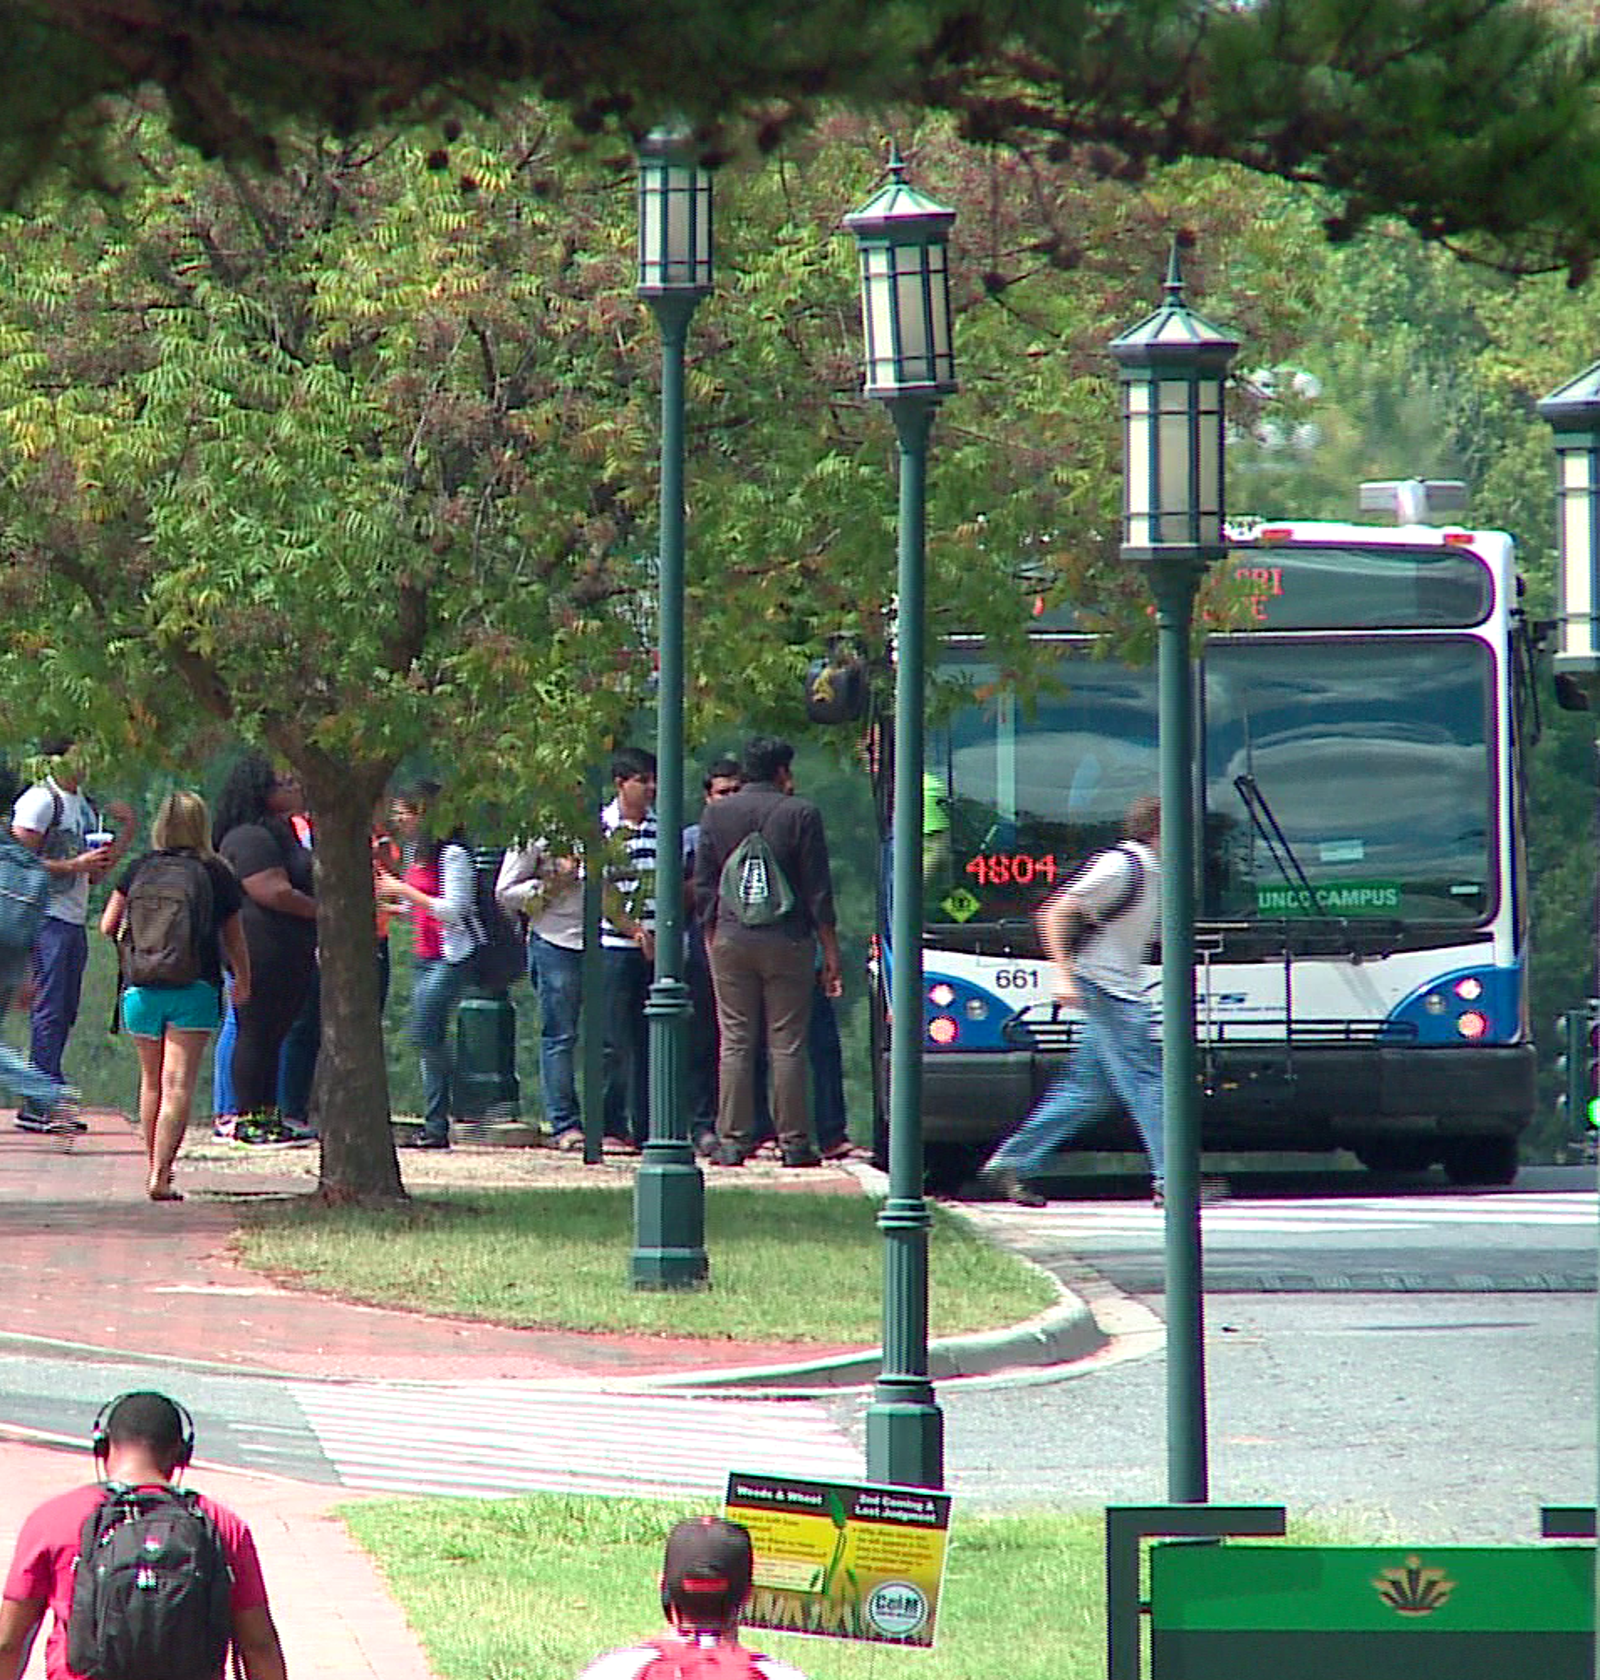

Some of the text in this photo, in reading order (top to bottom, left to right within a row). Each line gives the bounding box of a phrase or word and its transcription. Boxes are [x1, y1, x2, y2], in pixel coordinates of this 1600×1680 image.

[964, 853, 1058, 885] 4804
[1258, 887, 1398, 909] UNCC CAMPUS
[995, 969, 1040, 989] 661
